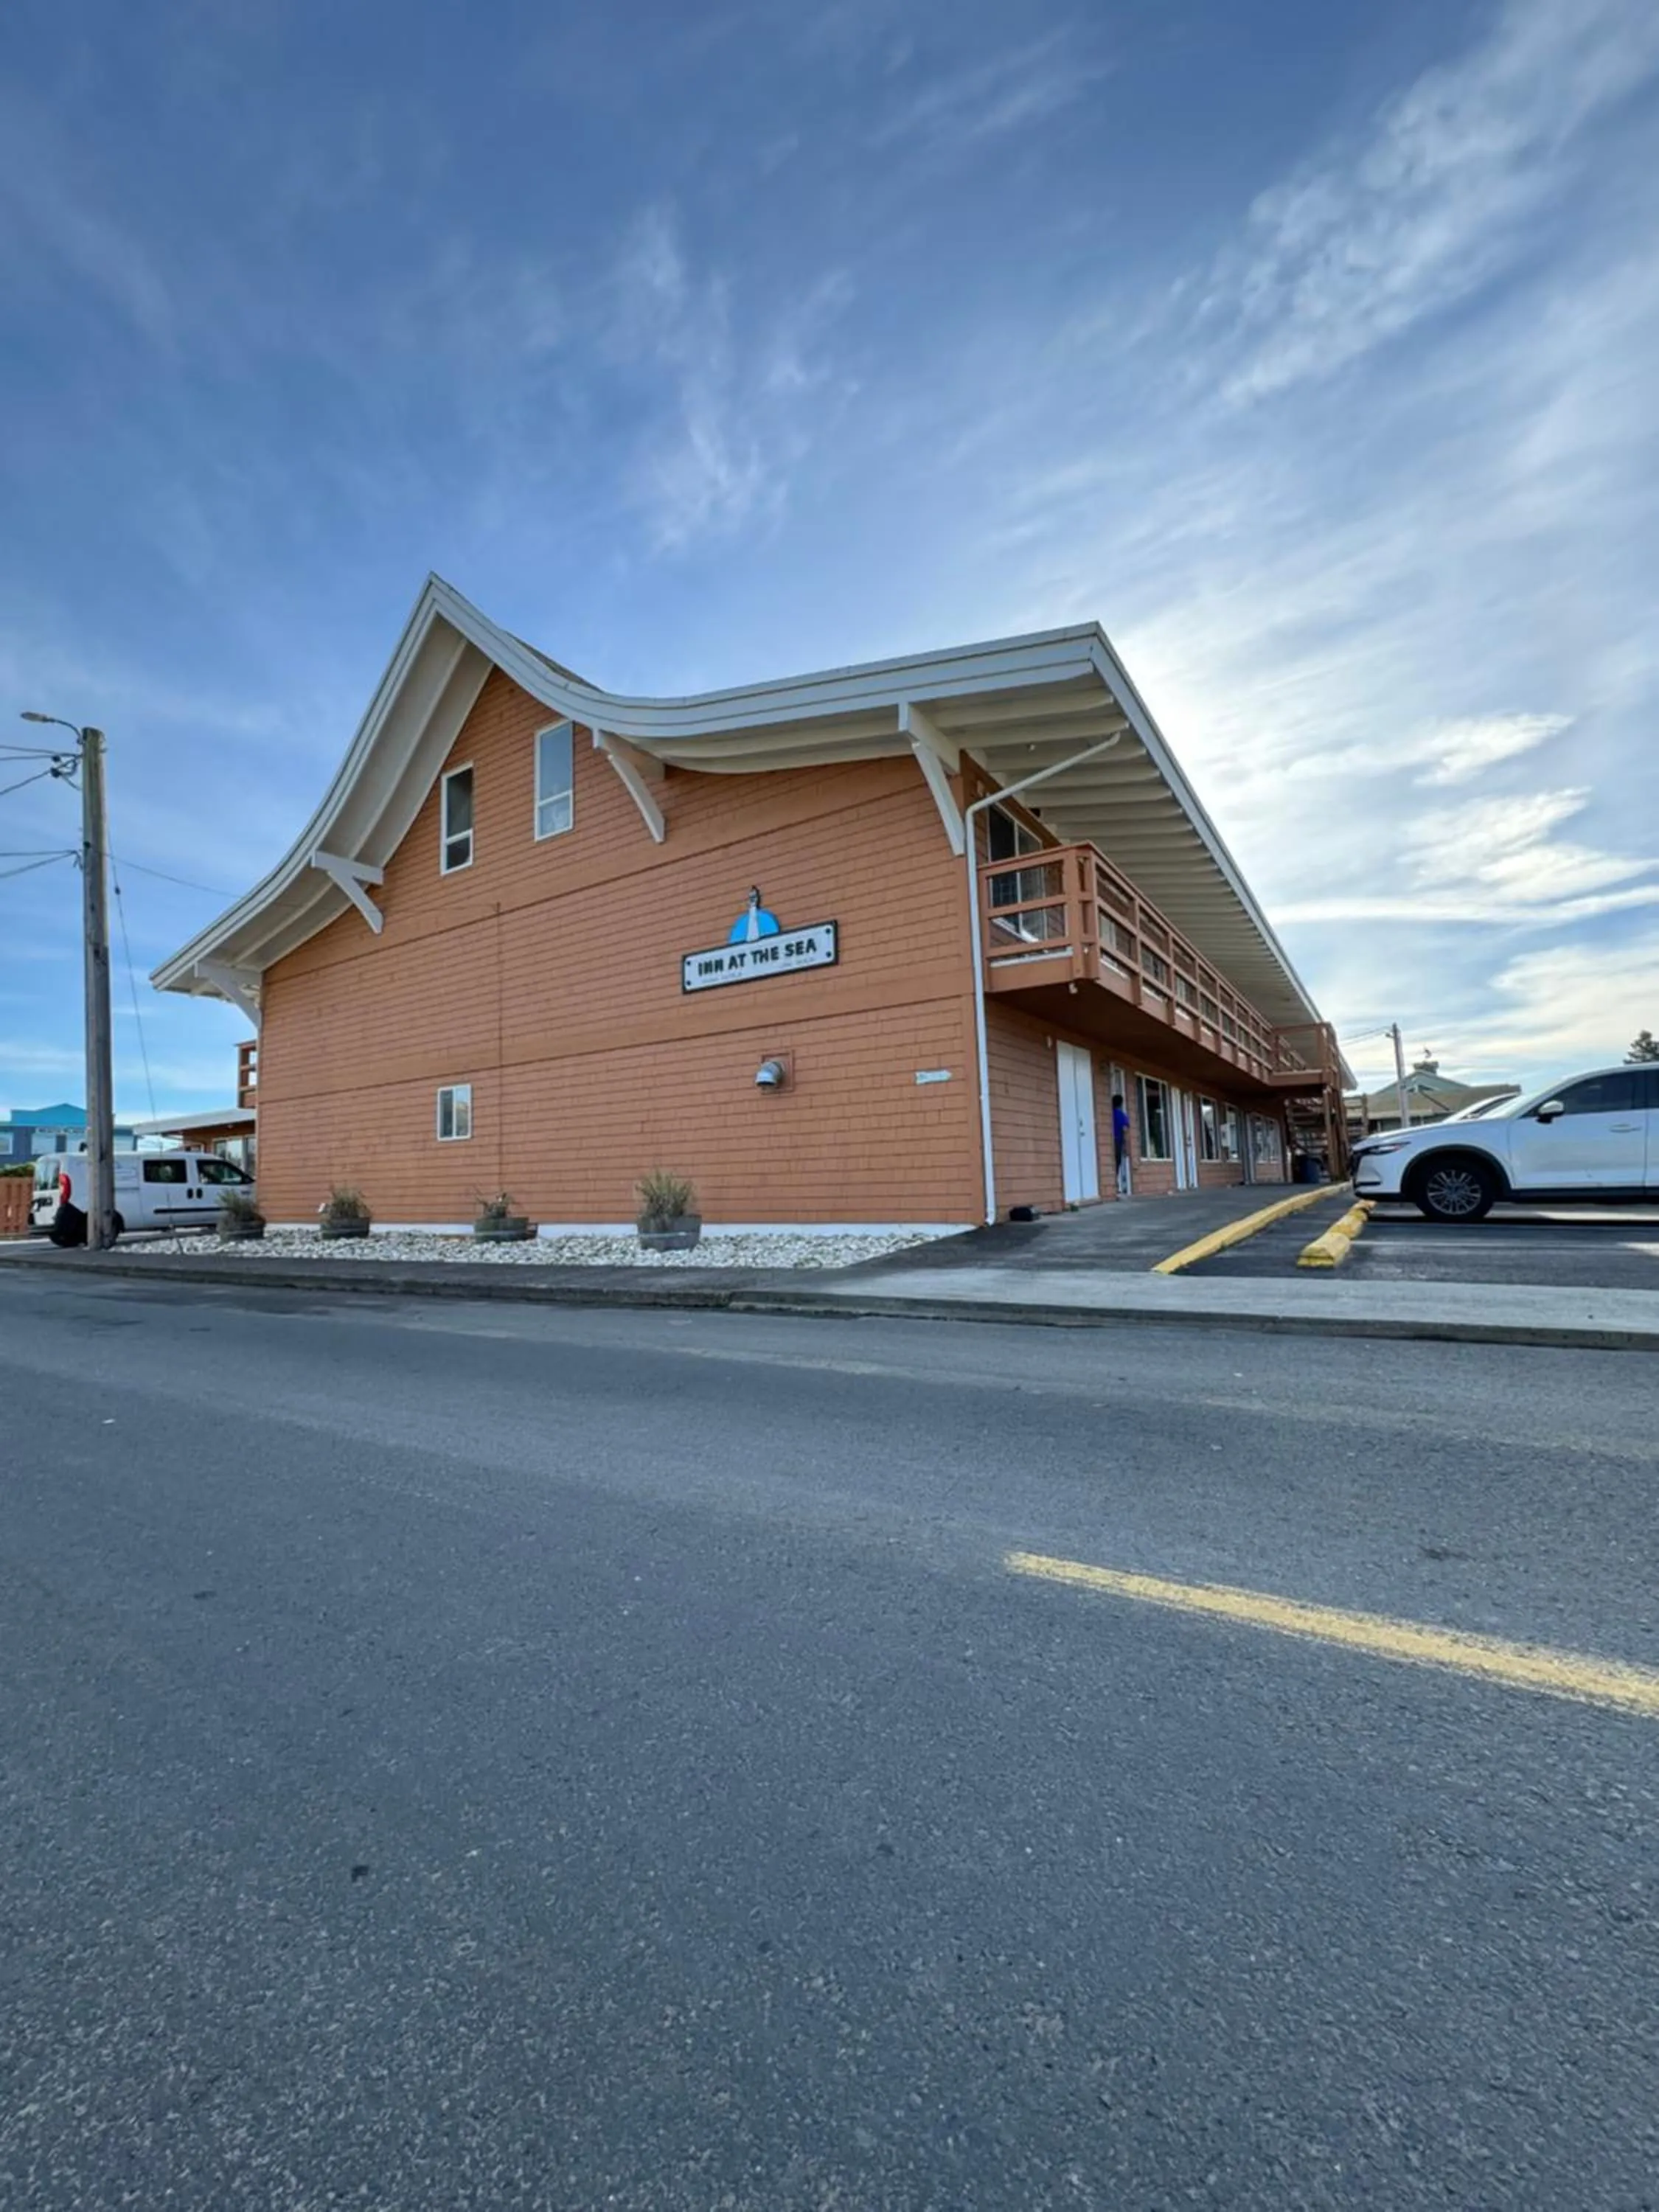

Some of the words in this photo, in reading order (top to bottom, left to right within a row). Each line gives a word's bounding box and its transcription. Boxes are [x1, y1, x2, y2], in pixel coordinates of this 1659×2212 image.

[698, 958, 724, 976] INN
[728, 953, 746, 970] AT
[751, 946, 779, 964] THE
[785, 938, 816, 957] SEA
